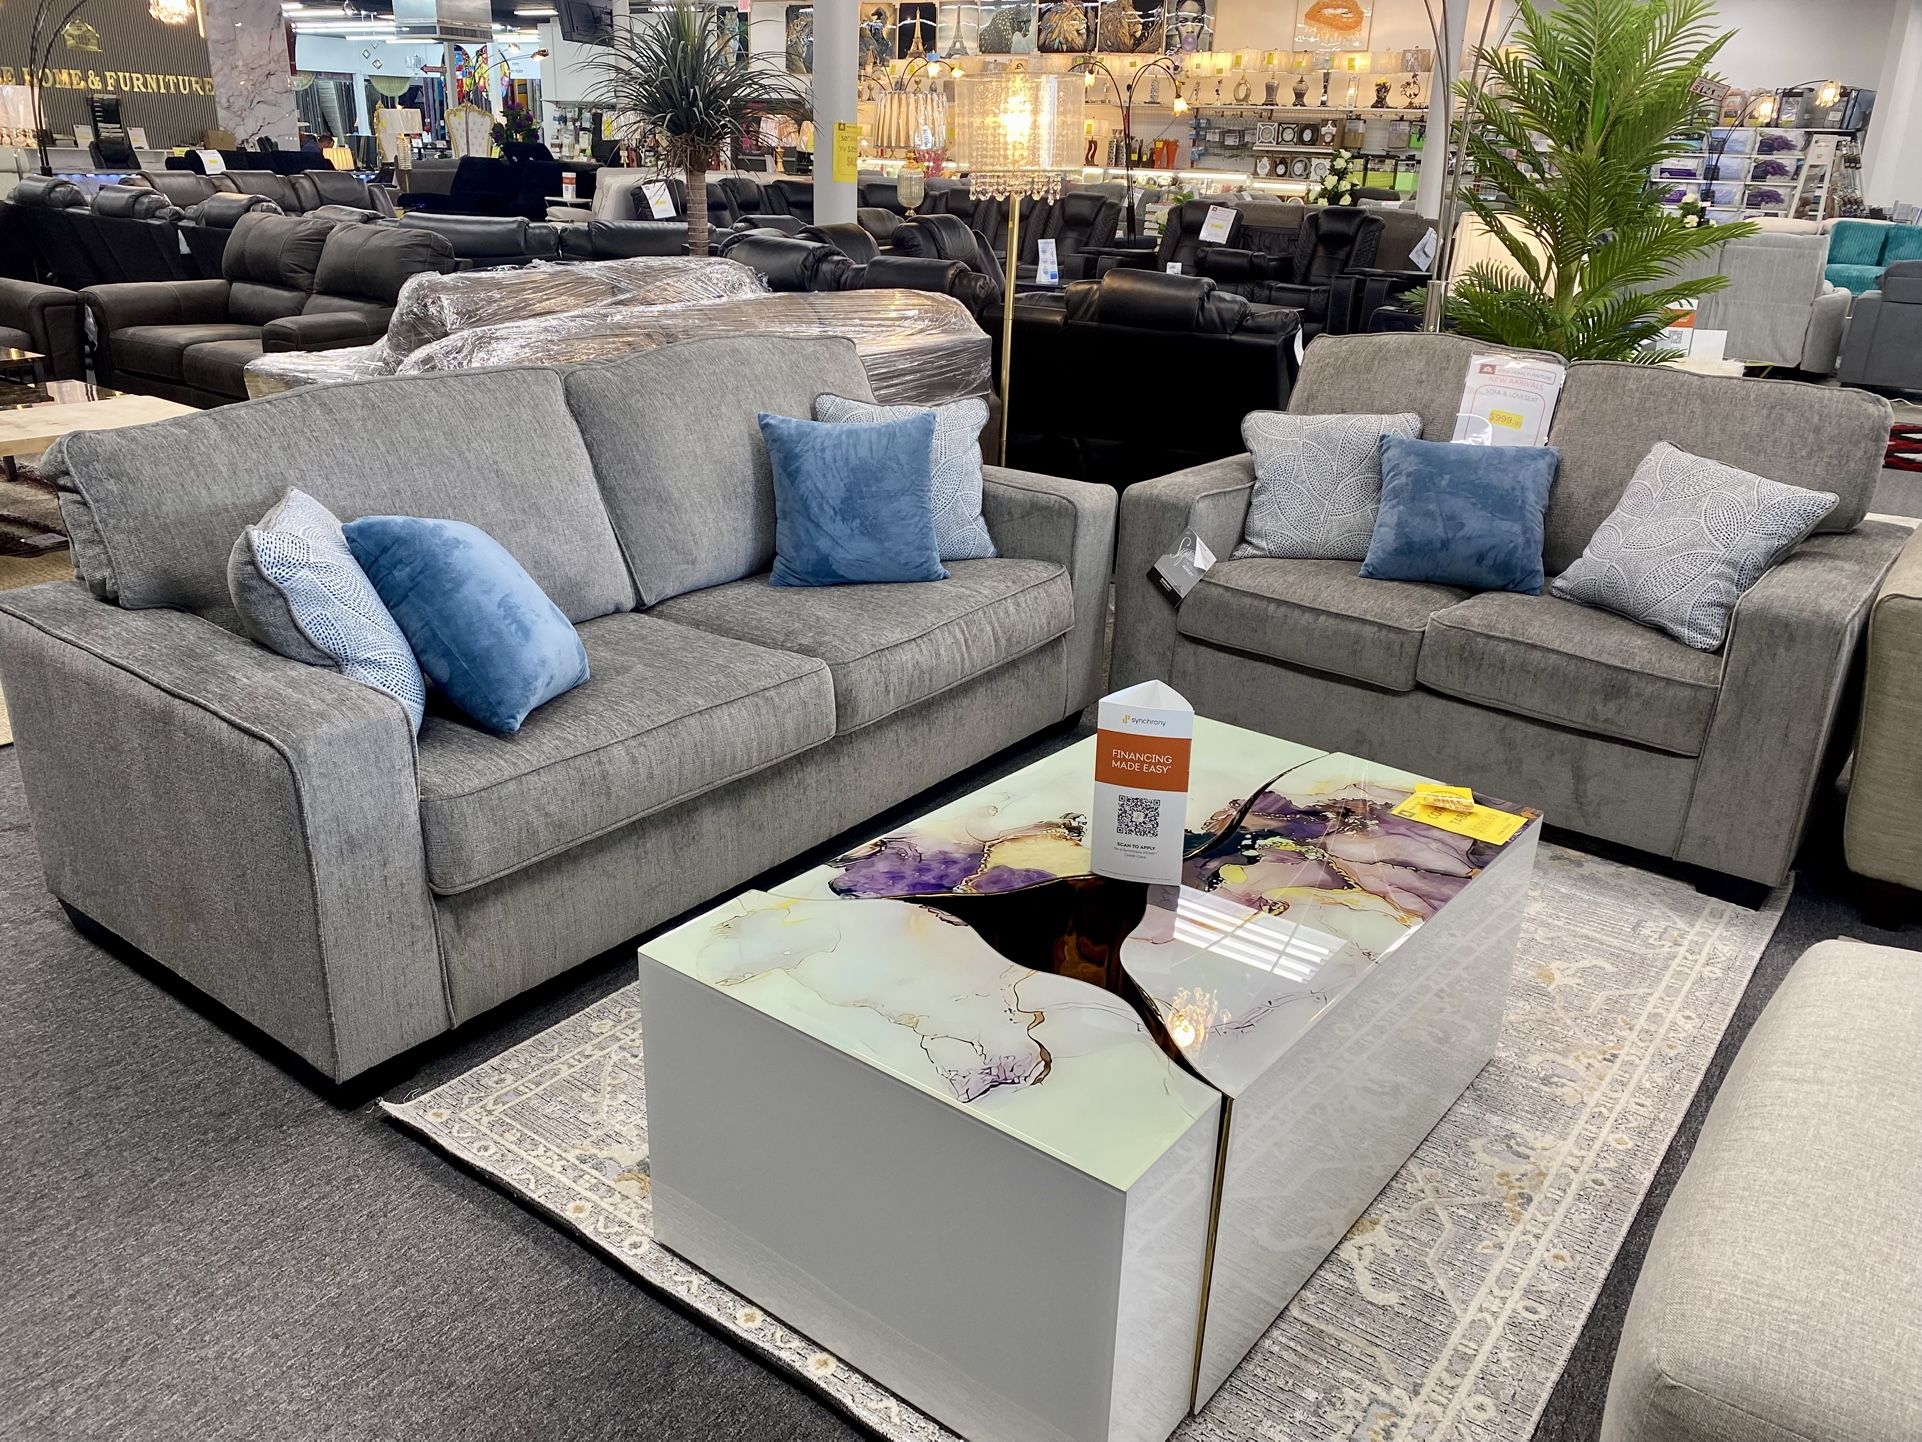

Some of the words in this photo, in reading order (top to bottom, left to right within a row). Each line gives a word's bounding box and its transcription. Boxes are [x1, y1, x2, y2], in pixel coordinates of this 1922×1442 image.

[0, 67, 16, 86] E
[88, 70, 102, 90] &
[104, 71, 215, 96] FURNITURE
[1508, 378, 1544, 391] ARRIVALS
[1486, 387, 1501, 395] SOFA
[1509, 392, 1540, 403] LOVESEAT
[1131, 717, 1167, 727] synchrony
[1112, 749, 1173, 764] FINANCING
[1111, 760, 1141, 772] MADE
